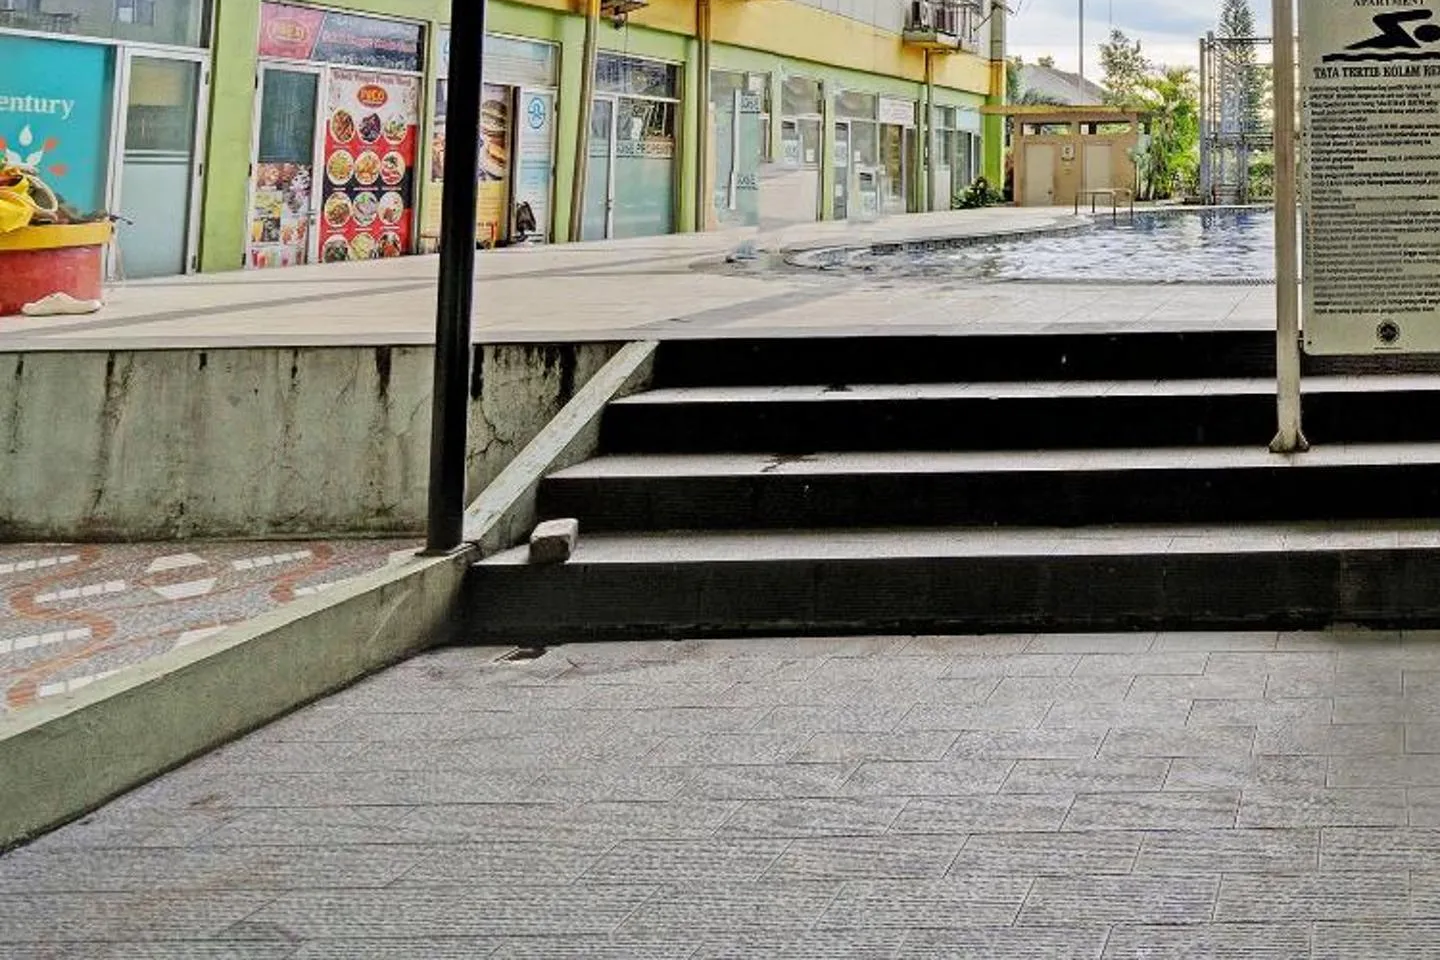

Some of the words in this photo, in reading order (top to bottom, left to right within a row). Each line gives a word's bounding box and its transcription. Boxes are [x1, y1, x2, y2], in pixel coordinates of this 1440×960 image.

[1313, 66, 1339, 79] TATA
[1342, 66, 1381, 78] TERTIB
[1383, 65, 1421, 78] KOLAM
